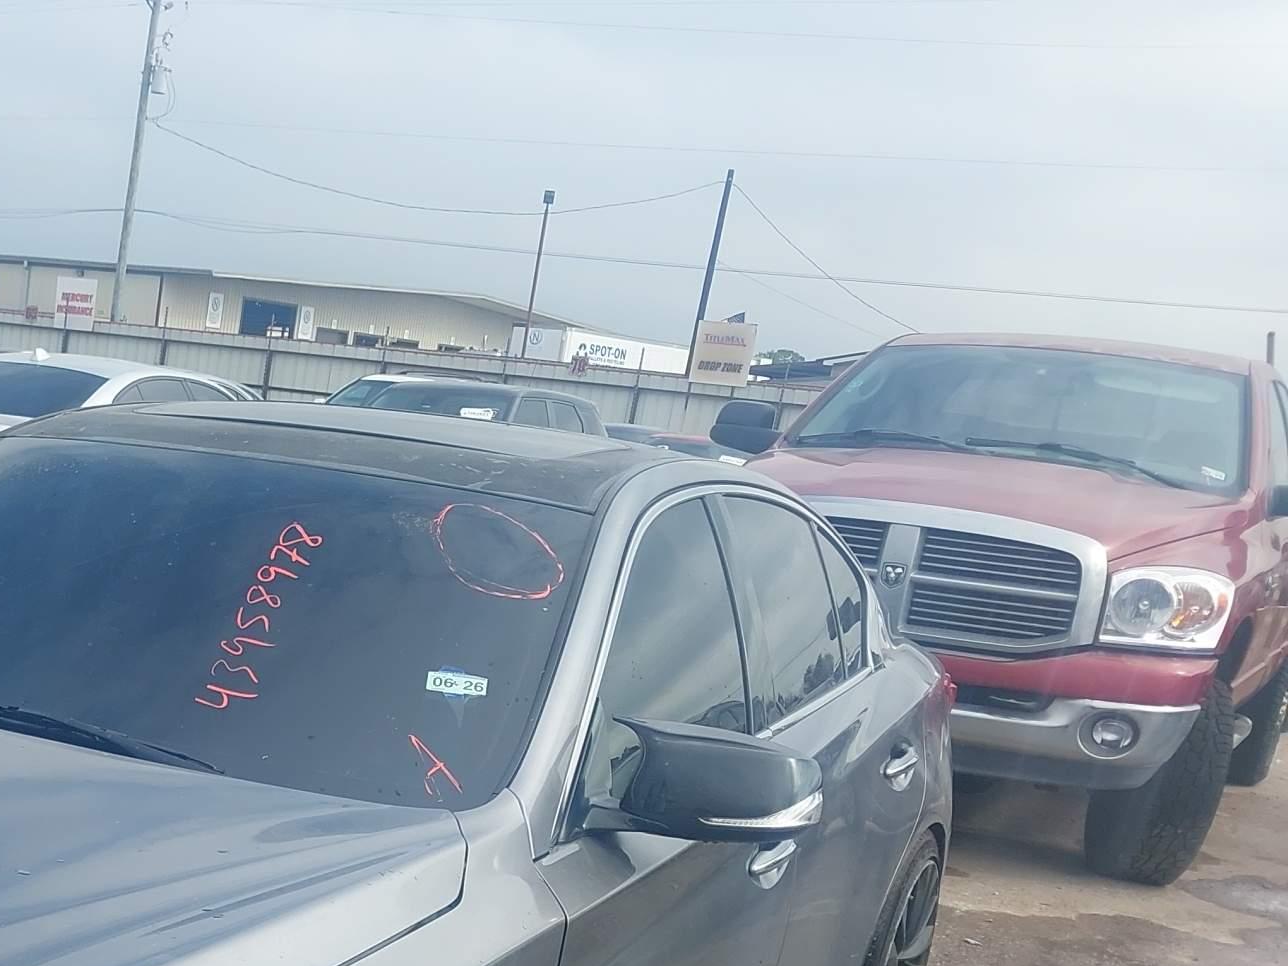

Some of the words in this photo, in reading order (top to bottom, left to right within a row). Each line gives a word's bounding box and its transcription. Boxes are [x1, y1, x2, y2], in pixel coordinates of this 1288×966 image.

[589, 343, 627, 361] SPOT-ON
[697, 360, 722, 372] DROP
[721, 362, 744, 373] ZONE
[195, 521, 323, 709] 43958978
[432, 677, 453, 688] 06
[462, 680, 484, 693] 26
